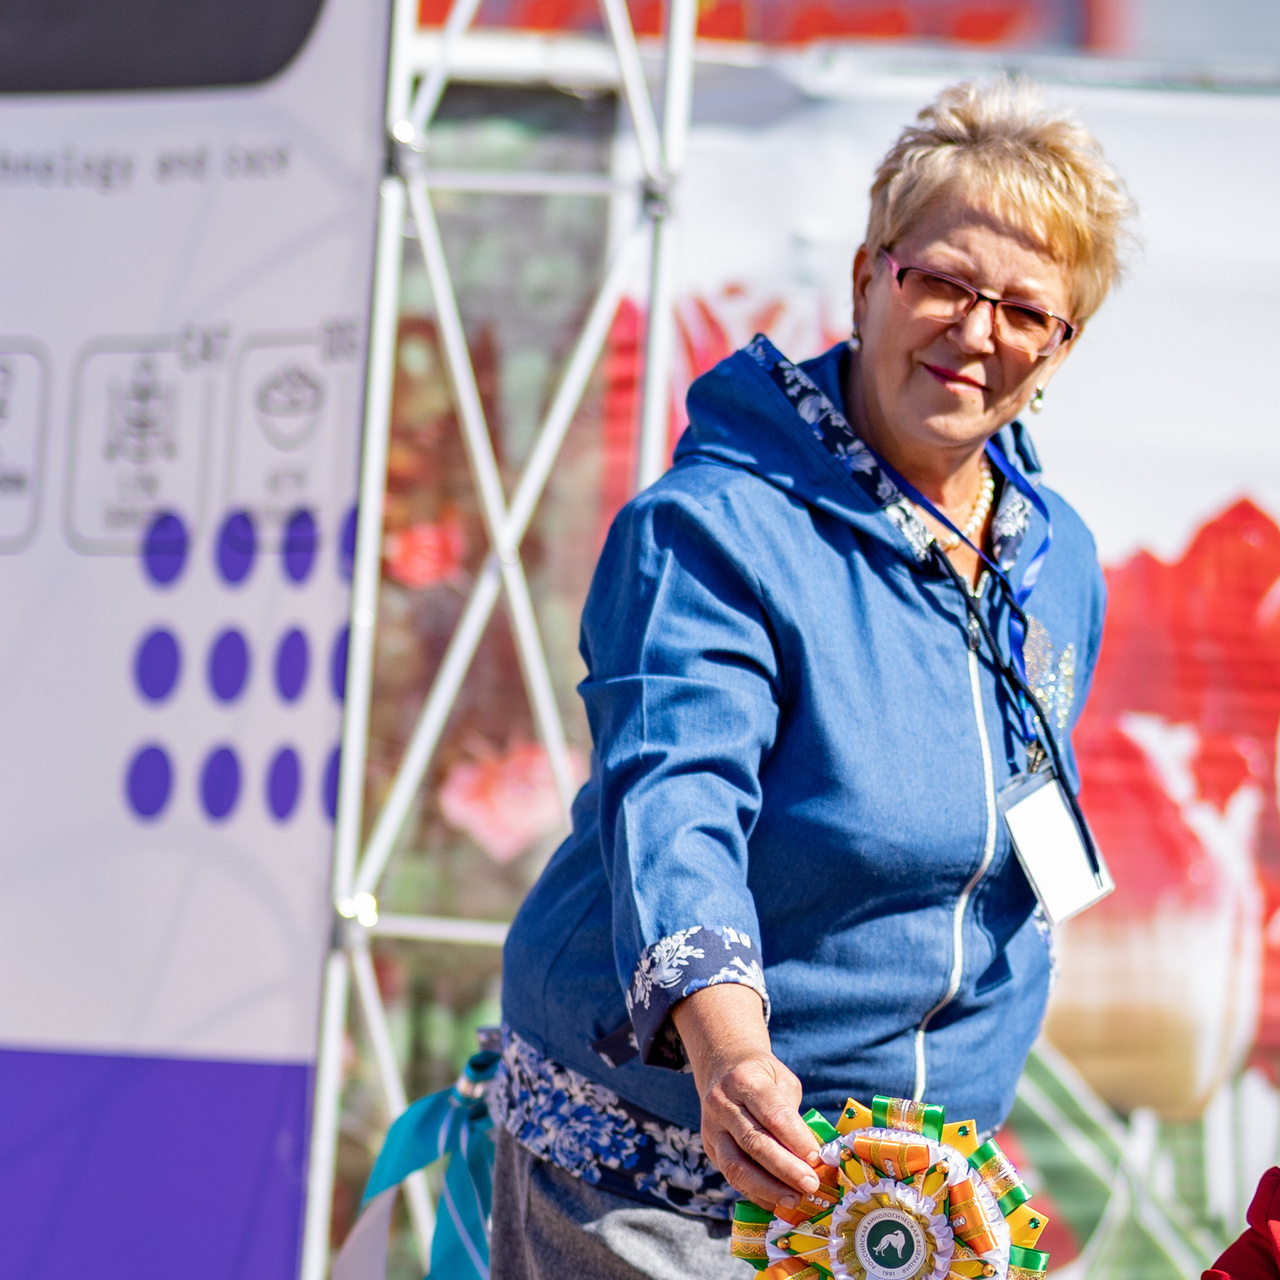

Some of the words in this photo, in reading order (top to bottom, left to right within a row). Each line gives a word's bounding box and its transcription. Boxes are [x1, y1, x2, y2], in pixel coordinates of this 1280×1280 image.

[867, 1212, 920, 1238] КИНОЛОГИЧЕСКАЯ
[859, 1225, 877, 1271] РОССИЙСКАЯ
[901, 1239, 922, 1274] ФЕДЕРАЦИЯ
